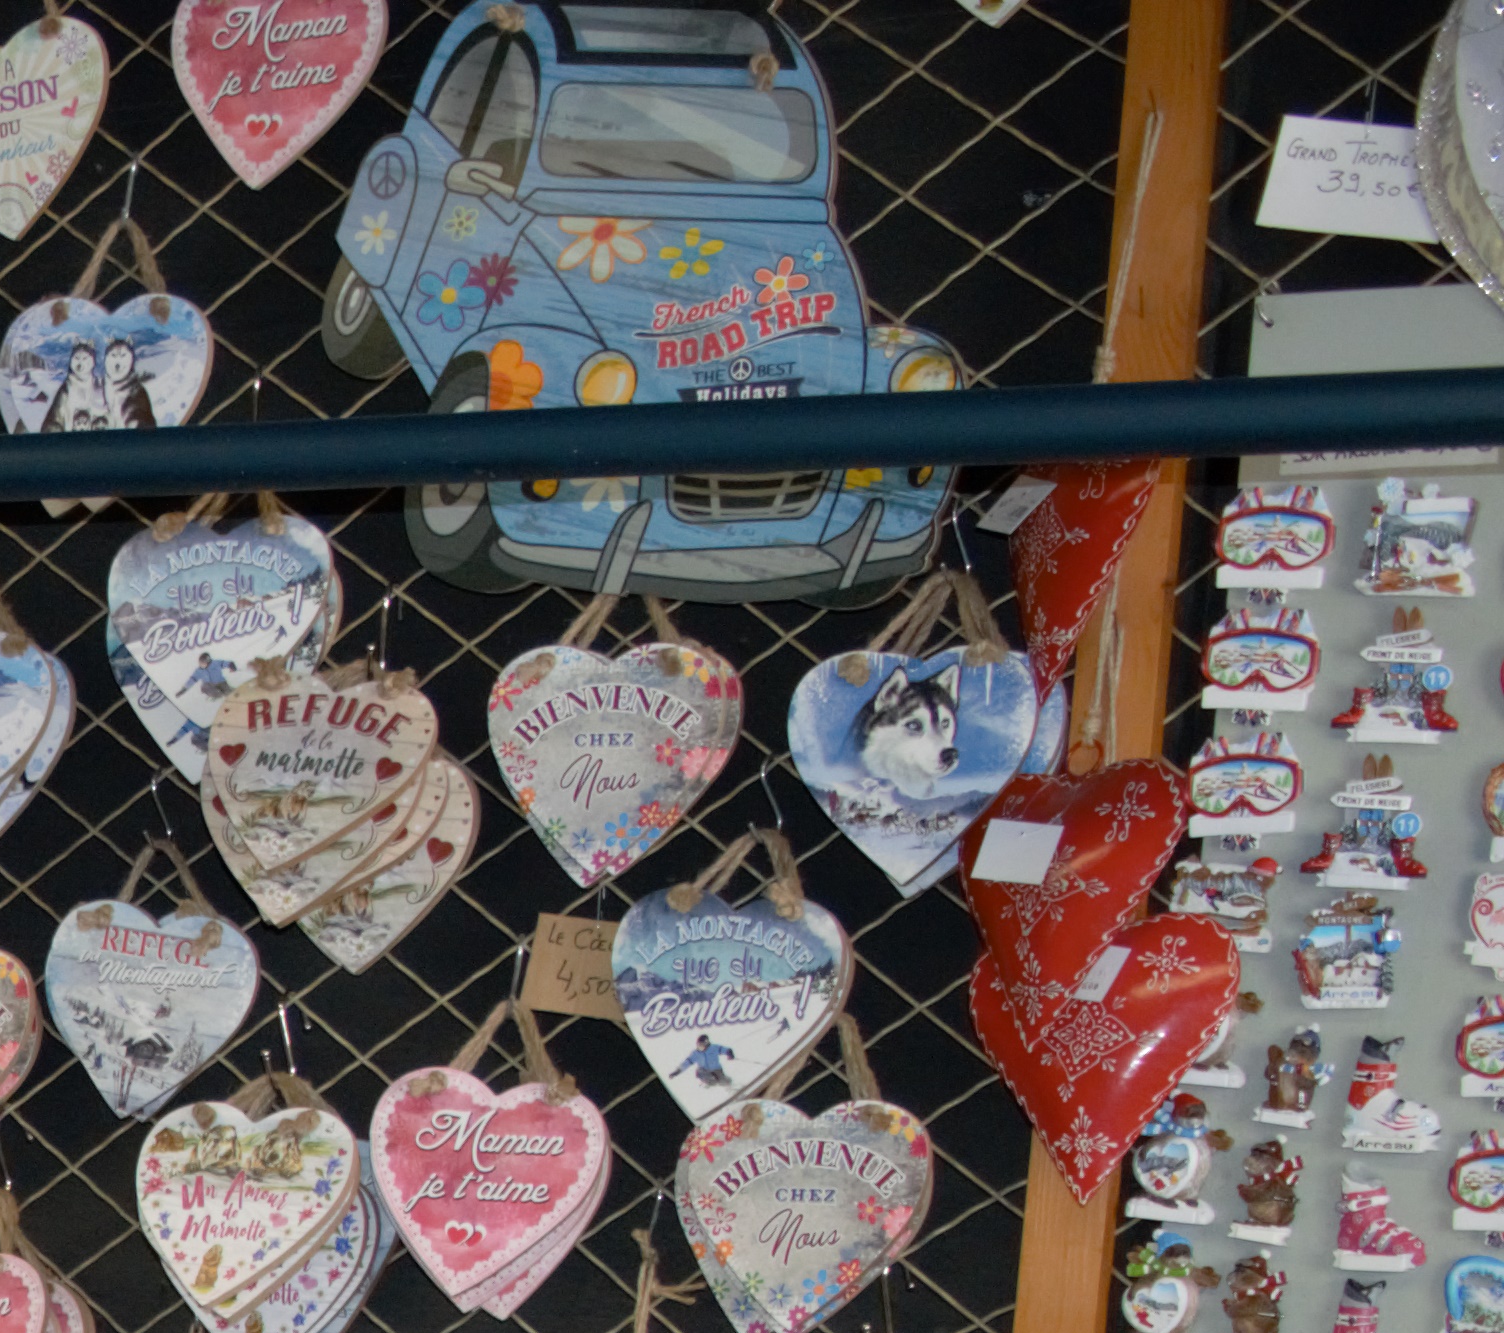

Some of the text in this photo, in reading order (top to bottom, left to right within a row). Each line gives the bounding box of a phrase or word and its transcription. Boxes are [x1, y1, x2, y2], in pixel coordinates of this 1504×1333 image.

[210, 3, 348, 62] Maman
[209, 58, 339, 111] je t'aime
[652, 286, 752, 331] French
[657, 292, 836, 369] ROAD TRIP
[693, 362, 796, 384] THE BEST
[129, 538, 303, 598] LA MONTAGNE
[166, 567, 255, 618] que du
[143, 602, 275, 664] Bonheur
[1428, 672, 1446, 686] 11
[246, 693, 413, 748] REFUGE
[512, 681, 703, 746] BIENVENUE
[574, 731, 635, 749] CHEZ
[255, 747, 365, 781] marmotte
[559, 755, 640, 809] Nous
[1397, 818, 1415, 833] 11
[101, 925, 210, 970] REFUGE
[636, 912, 816, 973] LA MONTAGNE
[672, 945, 764, 984] que du
[98, 958, 237, 992] Montagnard
[640, 992, 780, 1039] Bonheur
[415, 1108, 565, 1173] Maman
[1354, 1136, 1416, 1152] Arreau
[182, 1171, 289, 1210] Un Amour
[404, 1170, 551, 1214] je t'aime
[711, 1137, 907, 1201] BIENVENUE
[775, 1187, 837, 1204] CHEZ
[181, 1216, 267, 1244] Marmotte
[758, 1207, 840, 1266] Nous
